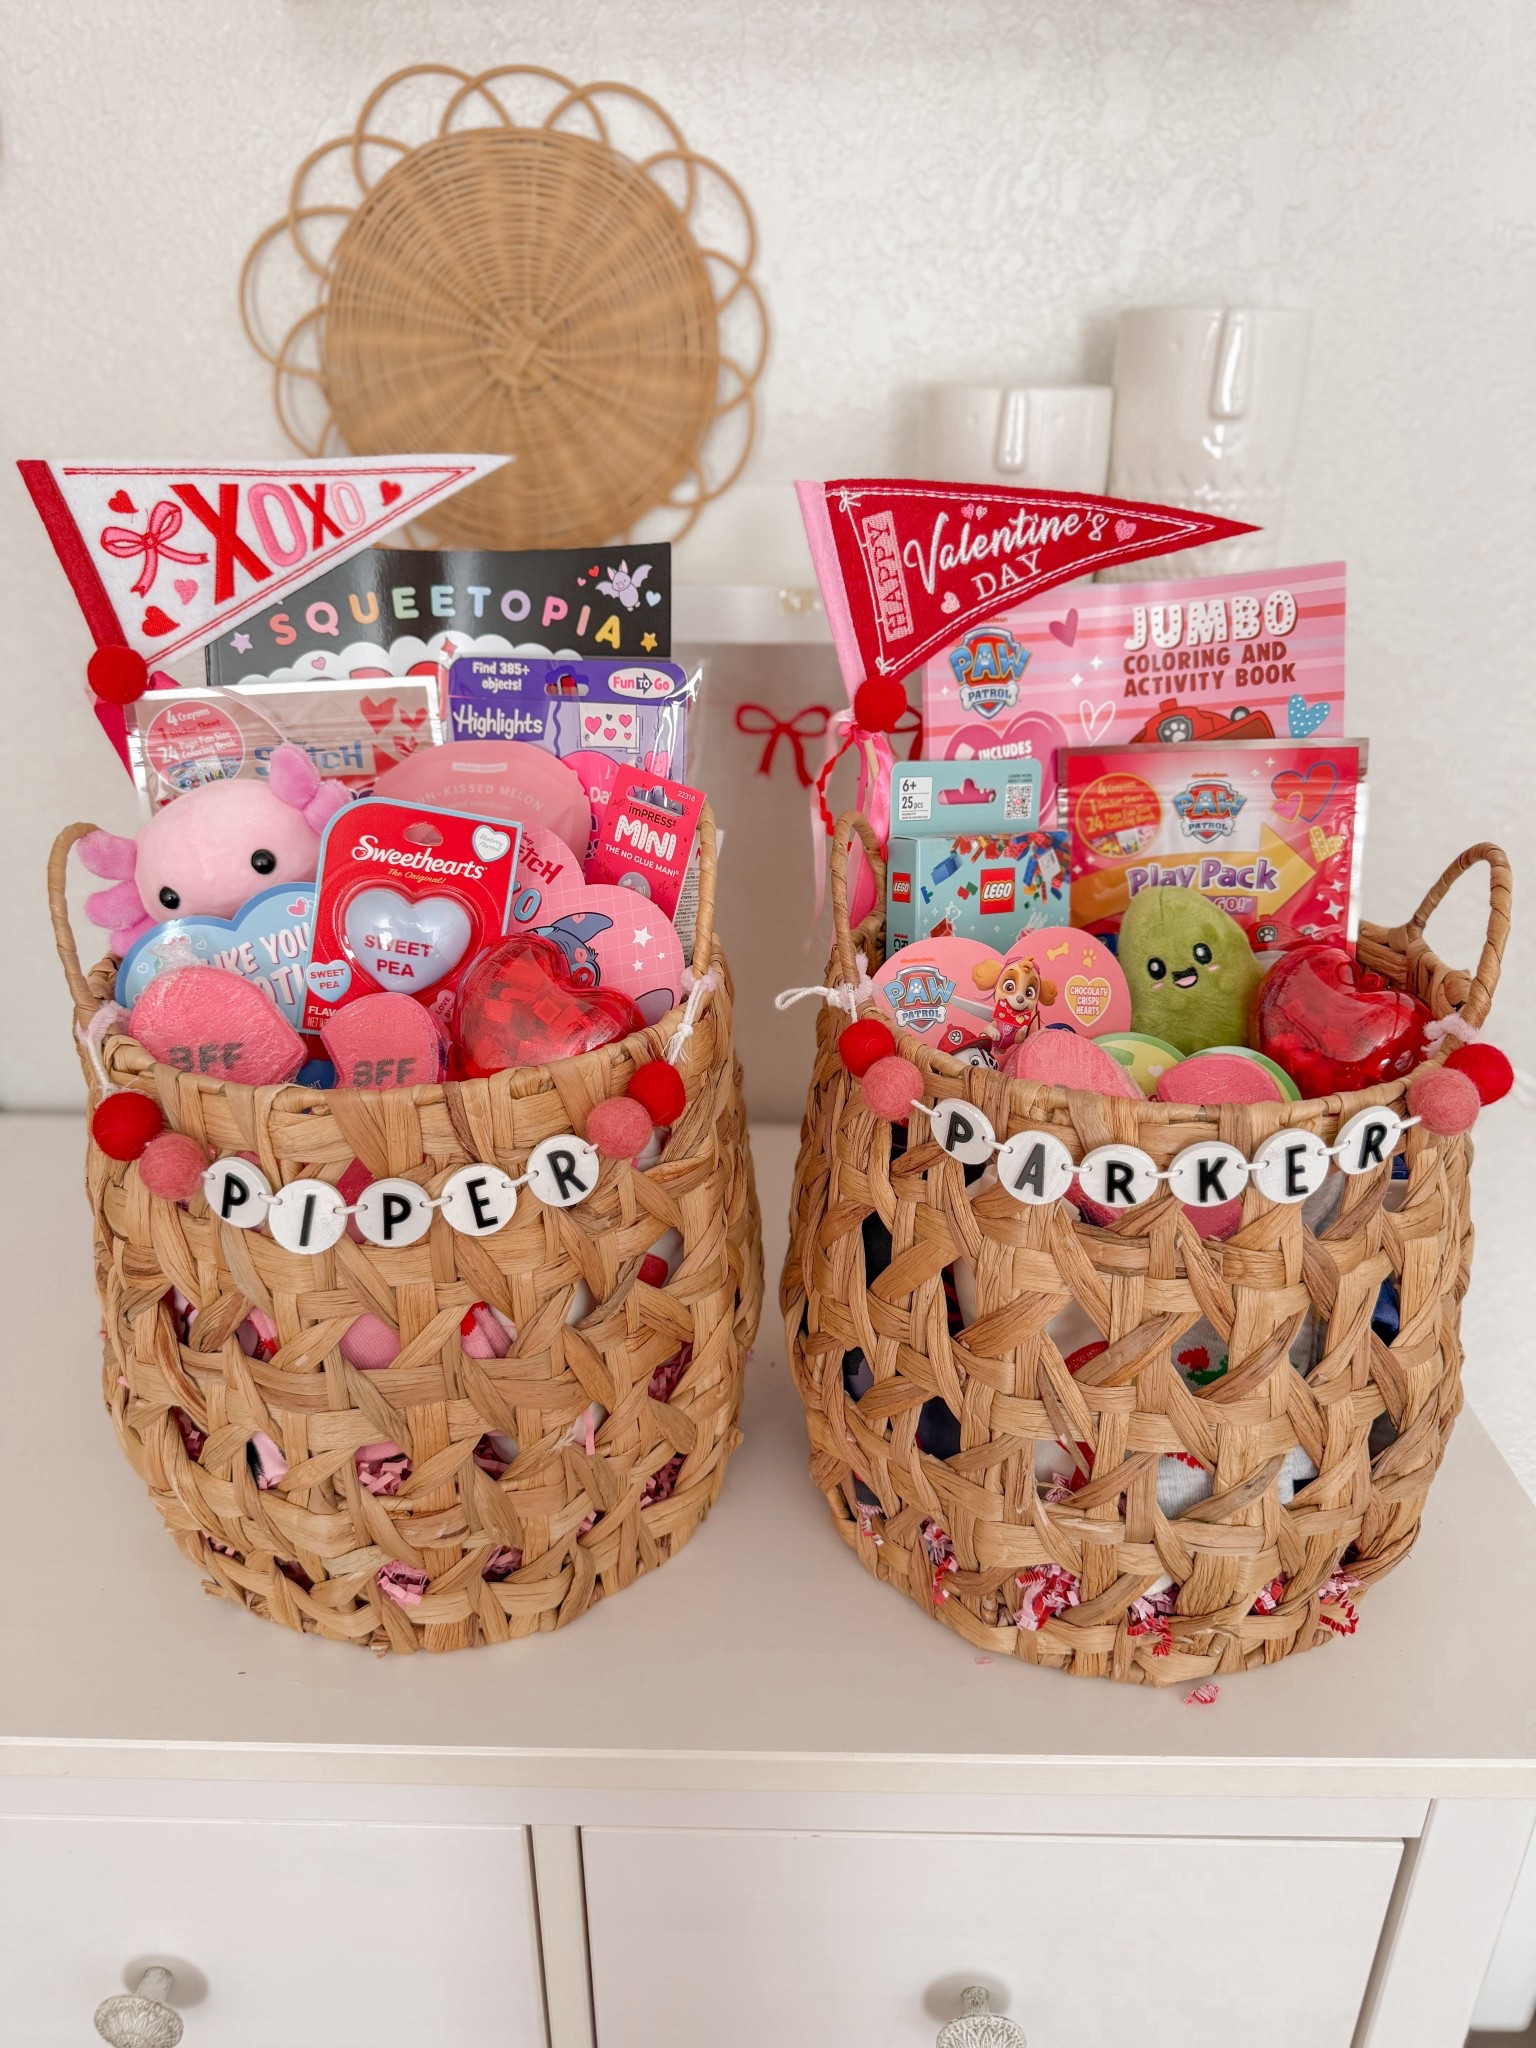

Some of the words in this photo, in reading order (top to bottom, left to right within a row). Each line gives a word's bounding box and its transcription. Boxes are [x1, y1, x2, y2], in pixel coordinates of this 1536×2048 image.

[168, 481, 366, 605] XOXO
[903, 507, 1109, 594] Valentine's
[867, 522, 908, 634] HAPPY
[970, 548, 1042, 601] DAY
[269, 586, 622, 649] SQUEETOPIA
[1123, 589, 1298, 651] JUMBO
[949, 643, 1032, 686] PAW
[1123, 647, 1231, 675] COLORING
[1241, 641, 1287, 665] AND
[472, 661, 497, 675] Find
[499, 661, 530, 676] 385+
[481, 676, 522, 694] objects!
[613, 676, 635, 689] Fun
[638, 679, 650, 689] TO
[654, 677, 670, 691] Go
[1123, 671, 1224, 698] ACTIVITY
[1235, 663, 1296, 688] BOOK
[968, 688, 1012, 701] PATROL
[167, 710, 178, 726] 4
[178, 708, 210, 721] Crayons
[452, 704, 543, 740] Highlights
[157, 745, 180, 763] 24
[978, 739, 1032, 760] INCLUDES
[902, 779, 917, 792] 6+
[1097, 782, 1107, 796] 4
[416, 784, 494, 804] UN-KISSED
[498, 786, 544, 811] MELON
[590, 786, 612, 805] Da
[902, 796, 913, 809] 25
[914, 802, 924, 811] pcs
[1172, 790, 1247, 818] PAW
[1086, 815, 1104, 833] 24
[1188, 821, 1228, 831] PATROL
[614, 815, 677, 861] MINI
[351, 835, 484, 880] Sweethearts
[605, 843, 620, 856] THE
[620, 850, 633, 860] NO
[633, 855, 654, 870] GLUE
[388, 868, 403, 877] The
[1128, 863, 1195, 898] Play
[1200, 858, 1278, 891] Pack
[893, 882, 909, 893] LEGO
[983, 881, 1013, 900] LEGO
[364, 934, 433, 958] SWEET
[310, 968, 346, 980] SWEET
[376, 959, 415, 978] PEA
[319, 980, 340, 990] PEA
[883, 976, 957, 1010] PAW
[1070, 985, 1108, 996] CHOCOLATY
[435, 996, 451, 1015] LOVE
[1075, 1005, 1100, 1016] HEARTS
[1077, 996, 1100, 1006] CRISPY
[308, 1005, 337, 1017] FLAV
[902, 1010, 941, 1021] PATROL
[353, 1058, 416, 1087] BFF
[944, 1110, 1388, 1205] PARKER
[221, 1149, 589, 1247] PIPER
